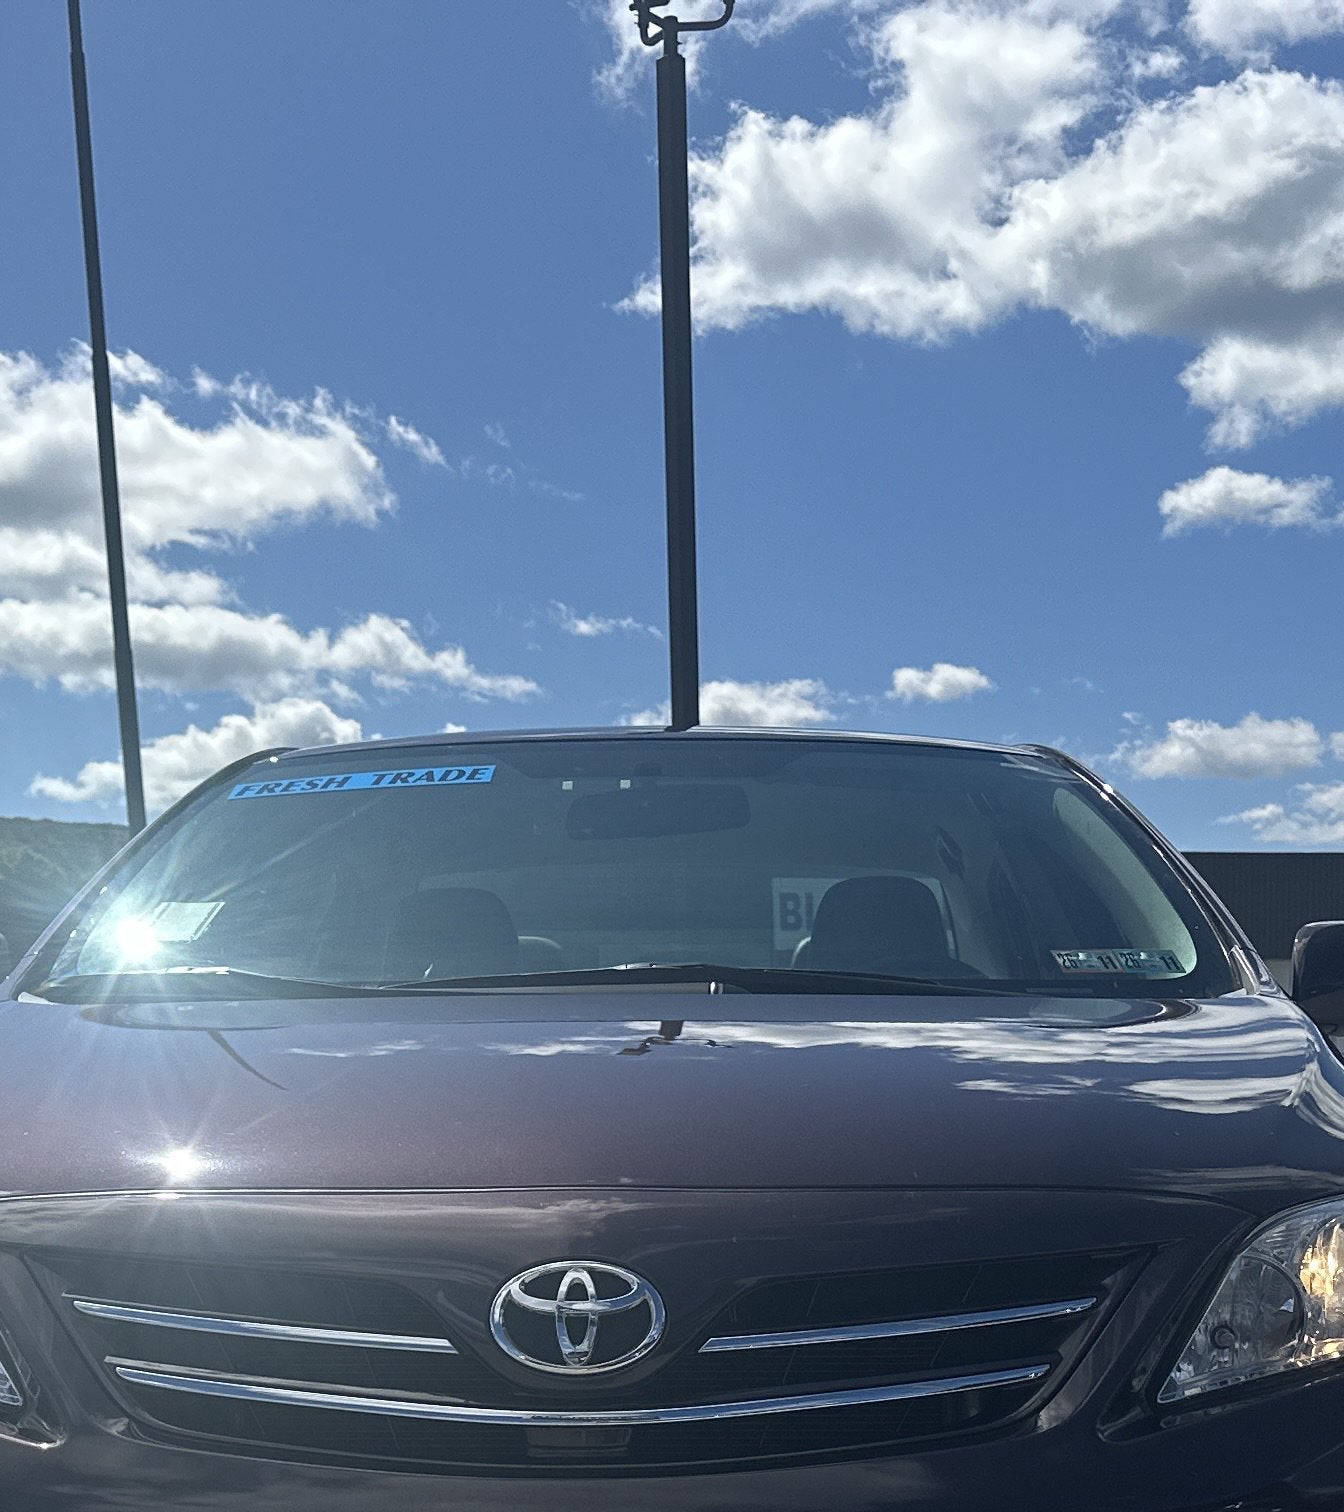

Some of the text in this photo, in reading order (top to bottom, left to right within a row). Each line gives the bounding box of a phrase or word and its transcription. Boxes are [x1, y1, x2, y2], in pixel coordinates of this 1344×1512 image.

[235, 767, 488, 796] FRESH TRADE
[1097, 956, 1118, 970] 11
[1159, 956, 1181, 971] 11
